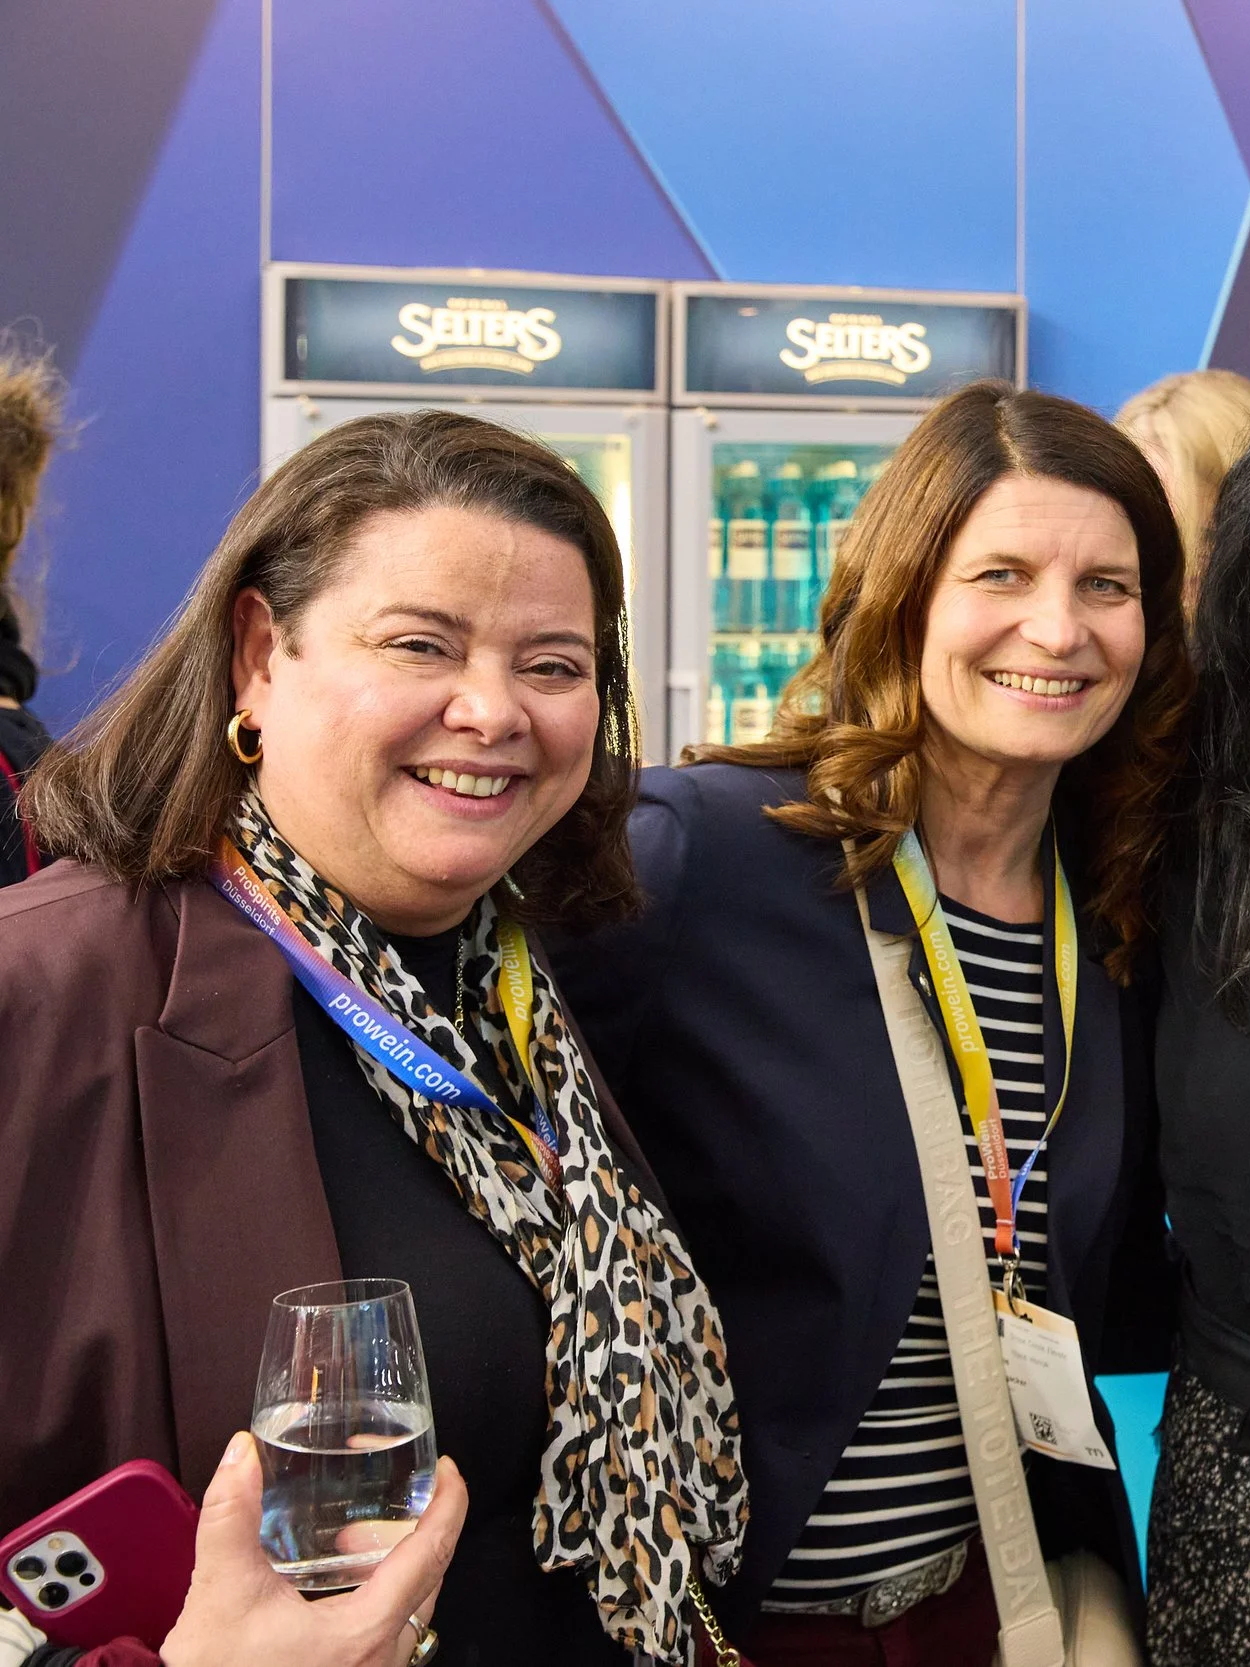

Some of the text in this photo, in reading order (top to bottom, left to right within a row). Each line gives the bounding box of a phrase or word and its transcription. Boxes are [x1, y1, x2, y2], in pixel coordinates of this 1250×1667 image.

[391, 303, 562, 361] SELTERS
[780, 318, 931, 373] SELTERS
[221, 879, 276, 936] Düsseldorf
[233, 866, 281, 926] ProSpirits
[929, 931, 980, 1053] prowein.com
[329, 992, 460, 1100] prowein.com
[978, 1120, 998, 1180] ProWein
[989, 1119, 1007, 1179] Düsseldorf
[999, 1534, 1044, 1613] BA
